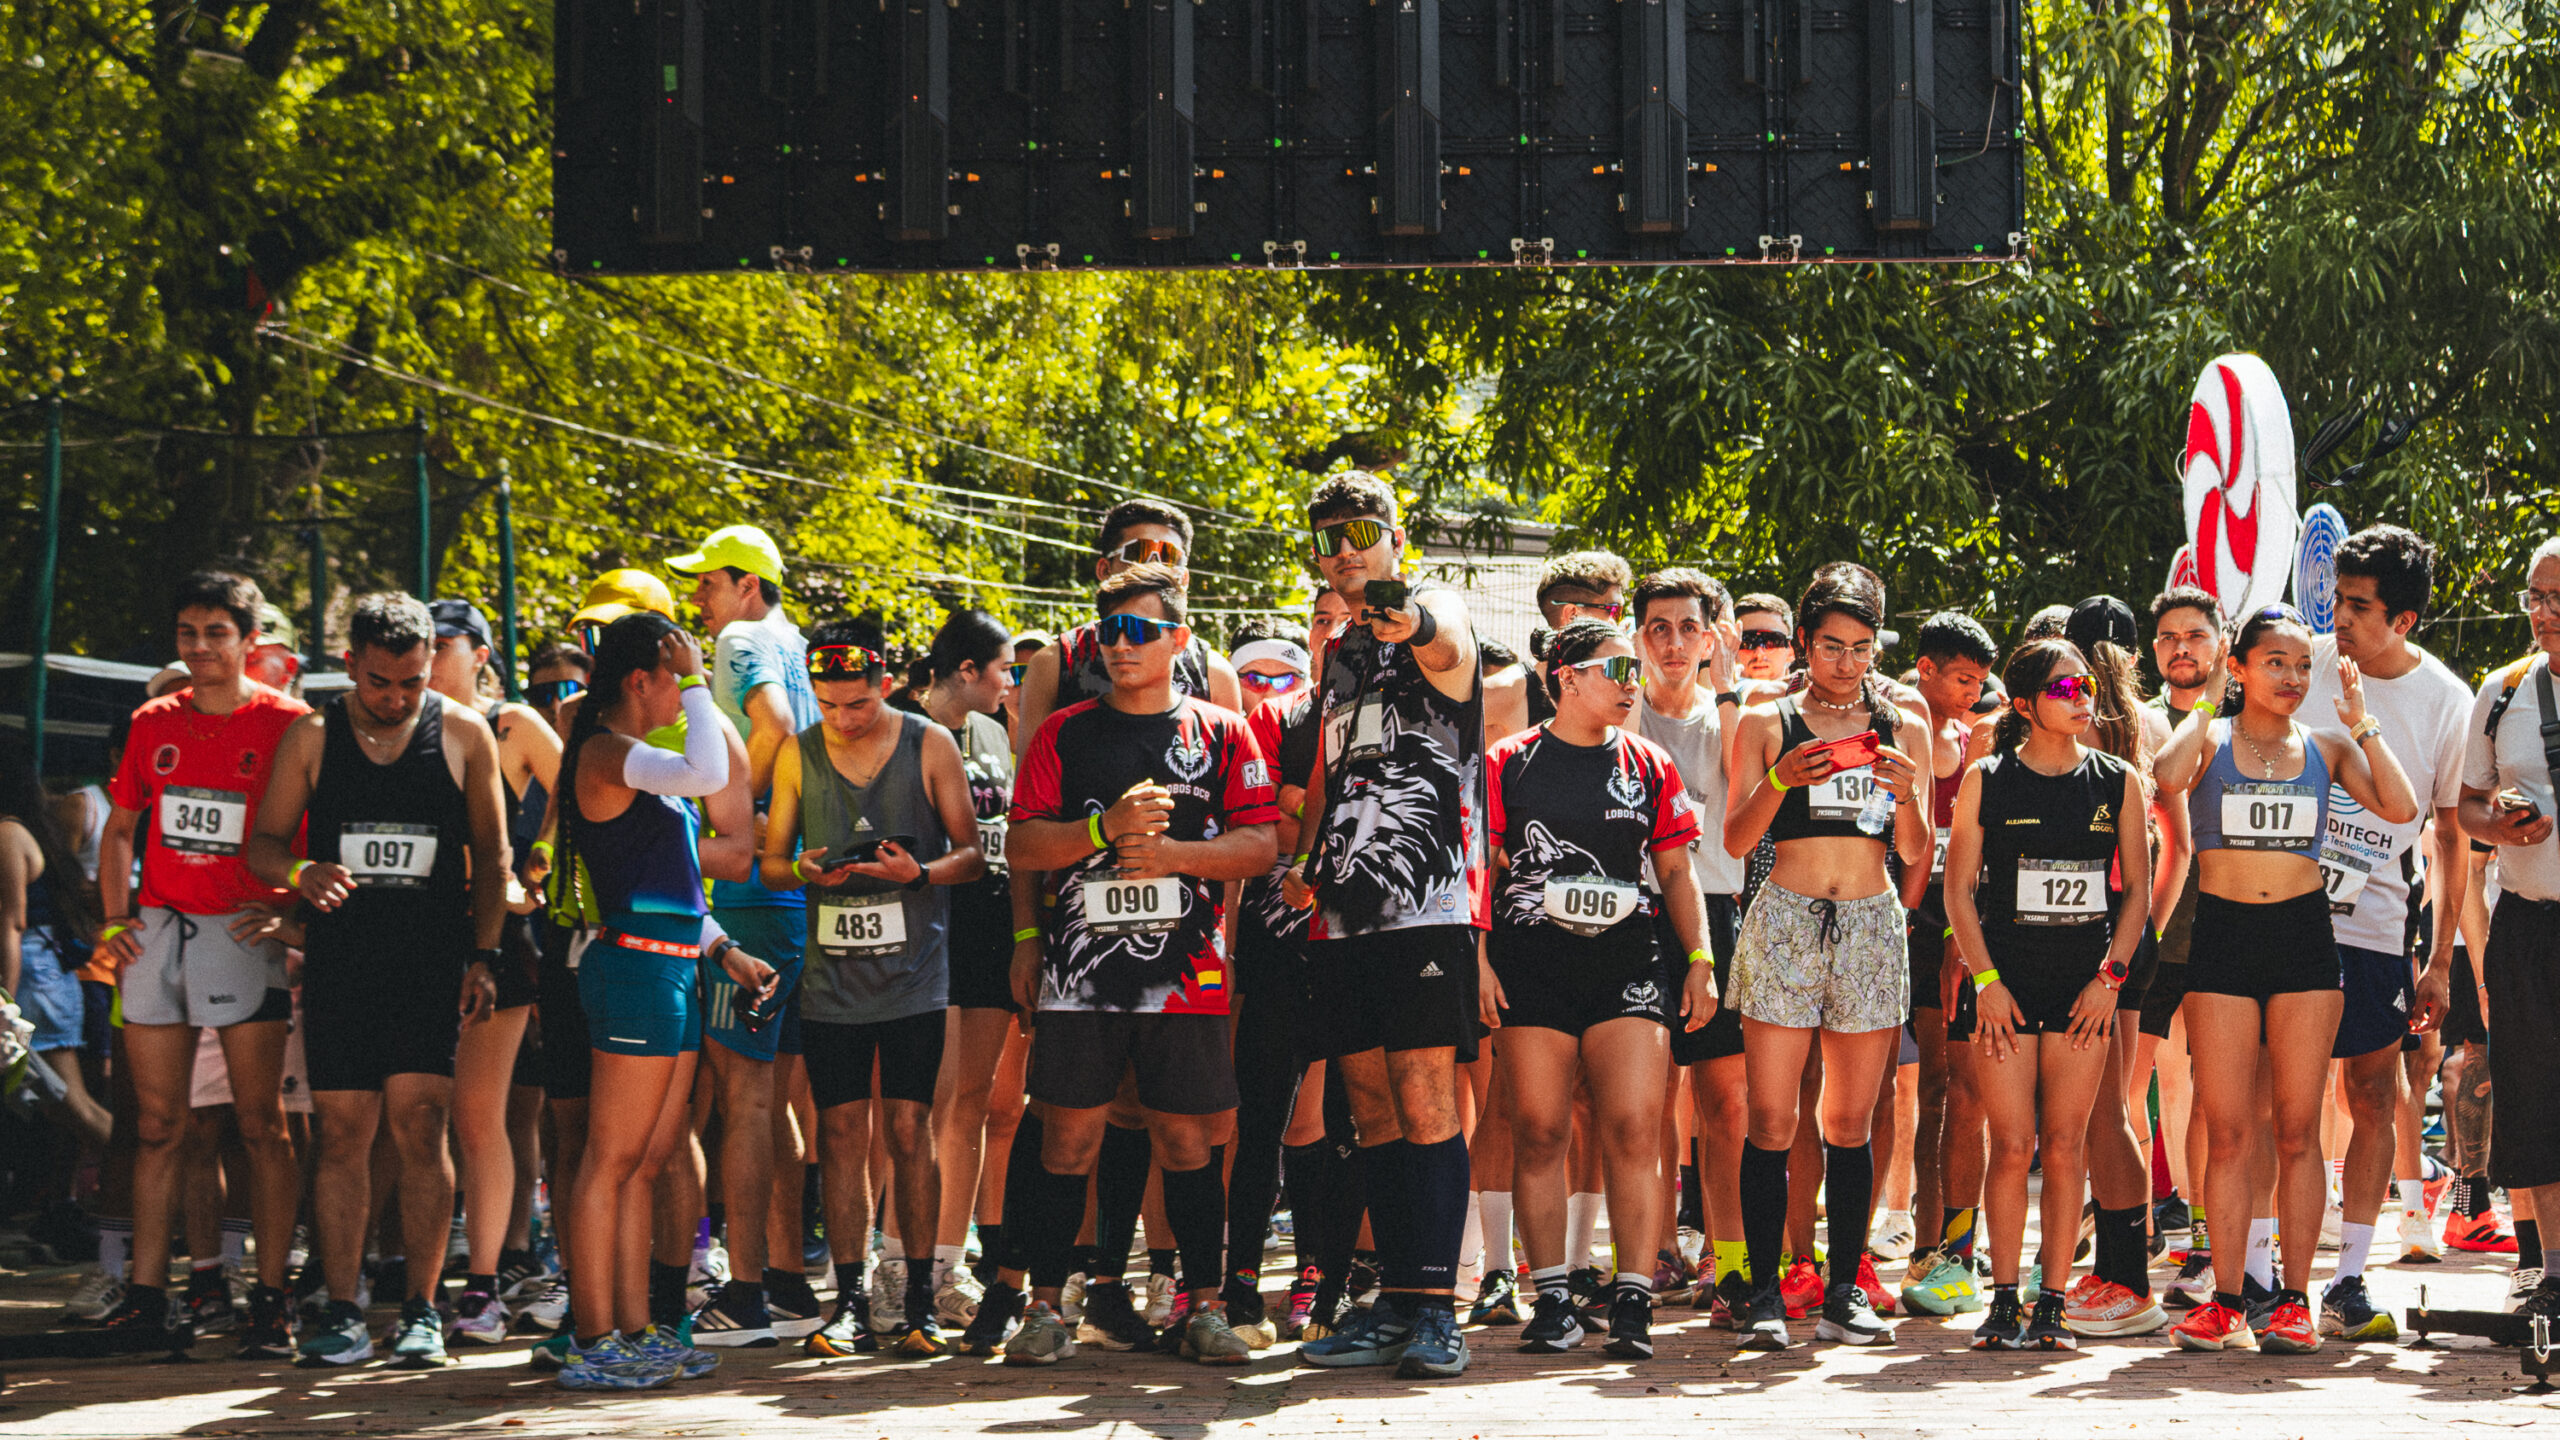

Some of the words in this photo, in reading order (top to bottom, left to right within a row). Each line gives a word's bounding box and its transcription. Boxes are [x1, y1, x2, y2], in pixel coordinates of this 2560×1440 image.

[1166, 783, 1192, 795] OBOS
[1193, 786, 1211, 802] OCR
[176, 804, 221, 834] 349
[1605, 808, 1635, 820] LOBOS
[2005, 818, 2041, 826] ALEJANDRA
[2250, 801, 2294, 830] 017
[2325, 818, 2393, 849] DITECH
[365, 840, 414, 868] 097
[2331, 835, 2390, 861] Tecnológicas
[1106, 884, 1159, 916] 090
[1564, 887, 1618, 919] 096
[2042, 878, 2088, 906] 122
[835, 912, 883, 940] 483
[2098, 1295, 2137, 1322] TERREX
